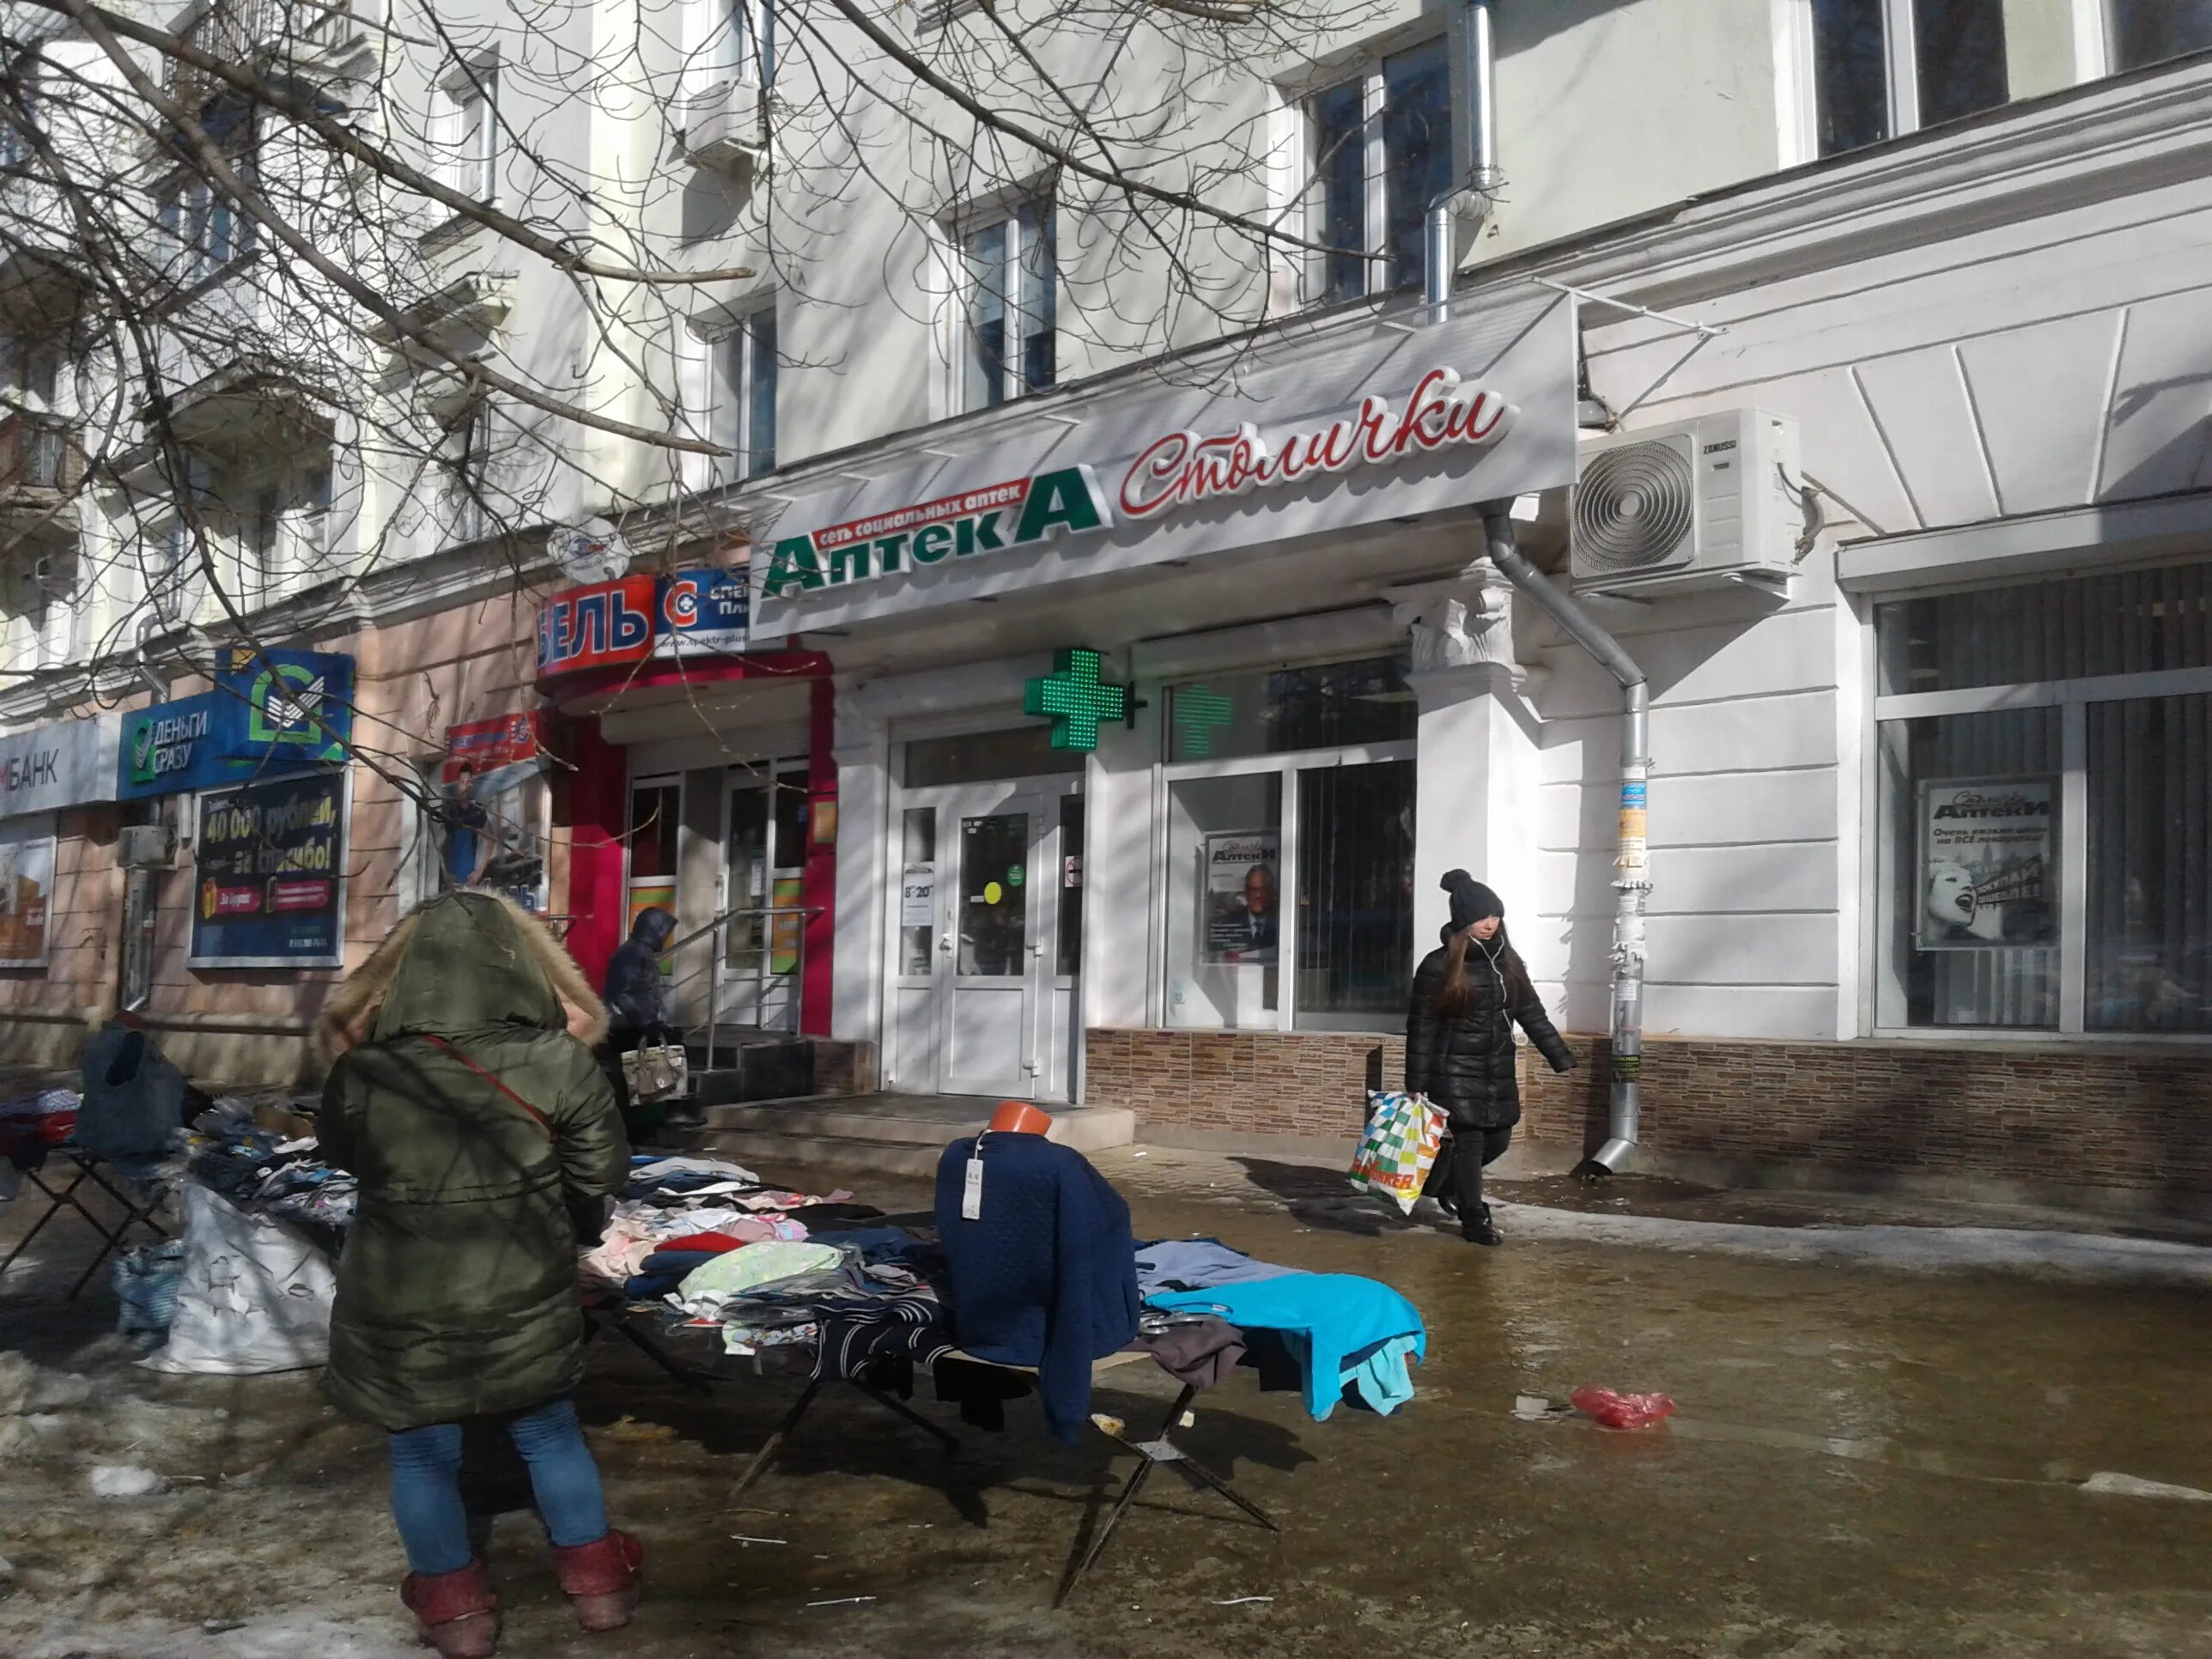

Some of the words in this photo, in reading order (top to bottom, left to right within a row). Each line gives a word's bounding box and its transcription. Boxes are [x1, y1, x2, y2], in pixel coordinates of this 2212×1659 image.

[1119, 368, 1509, 517] Столички
[1703, 439, 1737, 454] ZANUSSI
[819, 526, 853, 545] сеть
[854, 499, 962, 534] социальных
[963, 485, 1022, 510] аптек
[154, 710, 208, 746] ДЕНЬГИ
[9, 748, 59, 792] БАНК
[153, 742, 192, 773] СРАЗУ
[207, 809, 227, 843] 40
